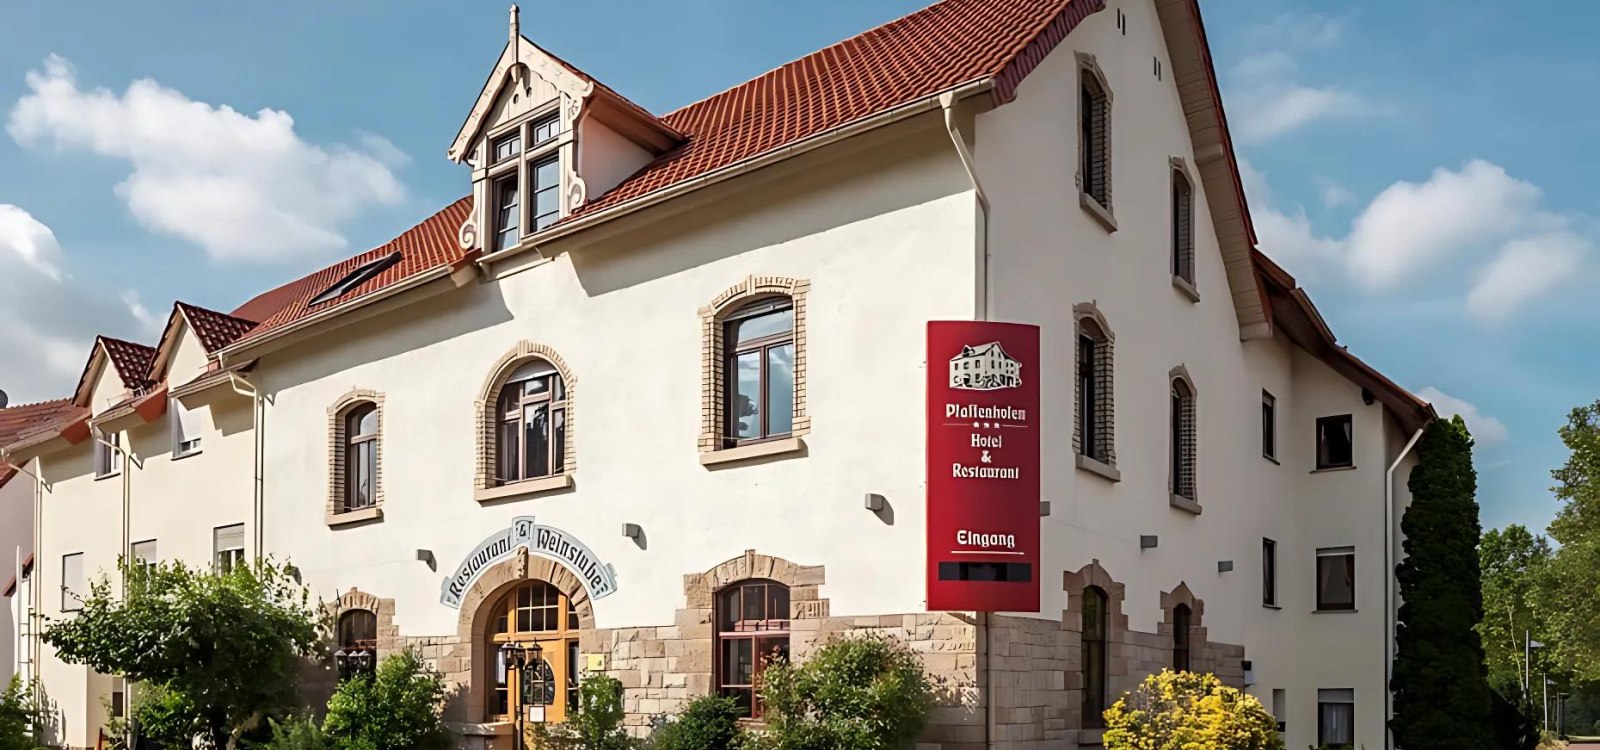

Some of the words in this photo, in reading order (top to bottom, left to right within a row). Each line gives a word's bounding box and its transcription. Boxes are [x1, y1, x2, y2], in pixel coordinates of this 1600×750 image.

[970, 433, 1002, 448] Hotel
[980, 450, 992, 463] &
[952, 462, 1020, 479] Restaurant
[956, 529, 1016, 548] Eingang
[449, 535, 512, 597] Restaurant
[519, 523, 527, 537] &
[537, 528, 602, 587] Weinstube
